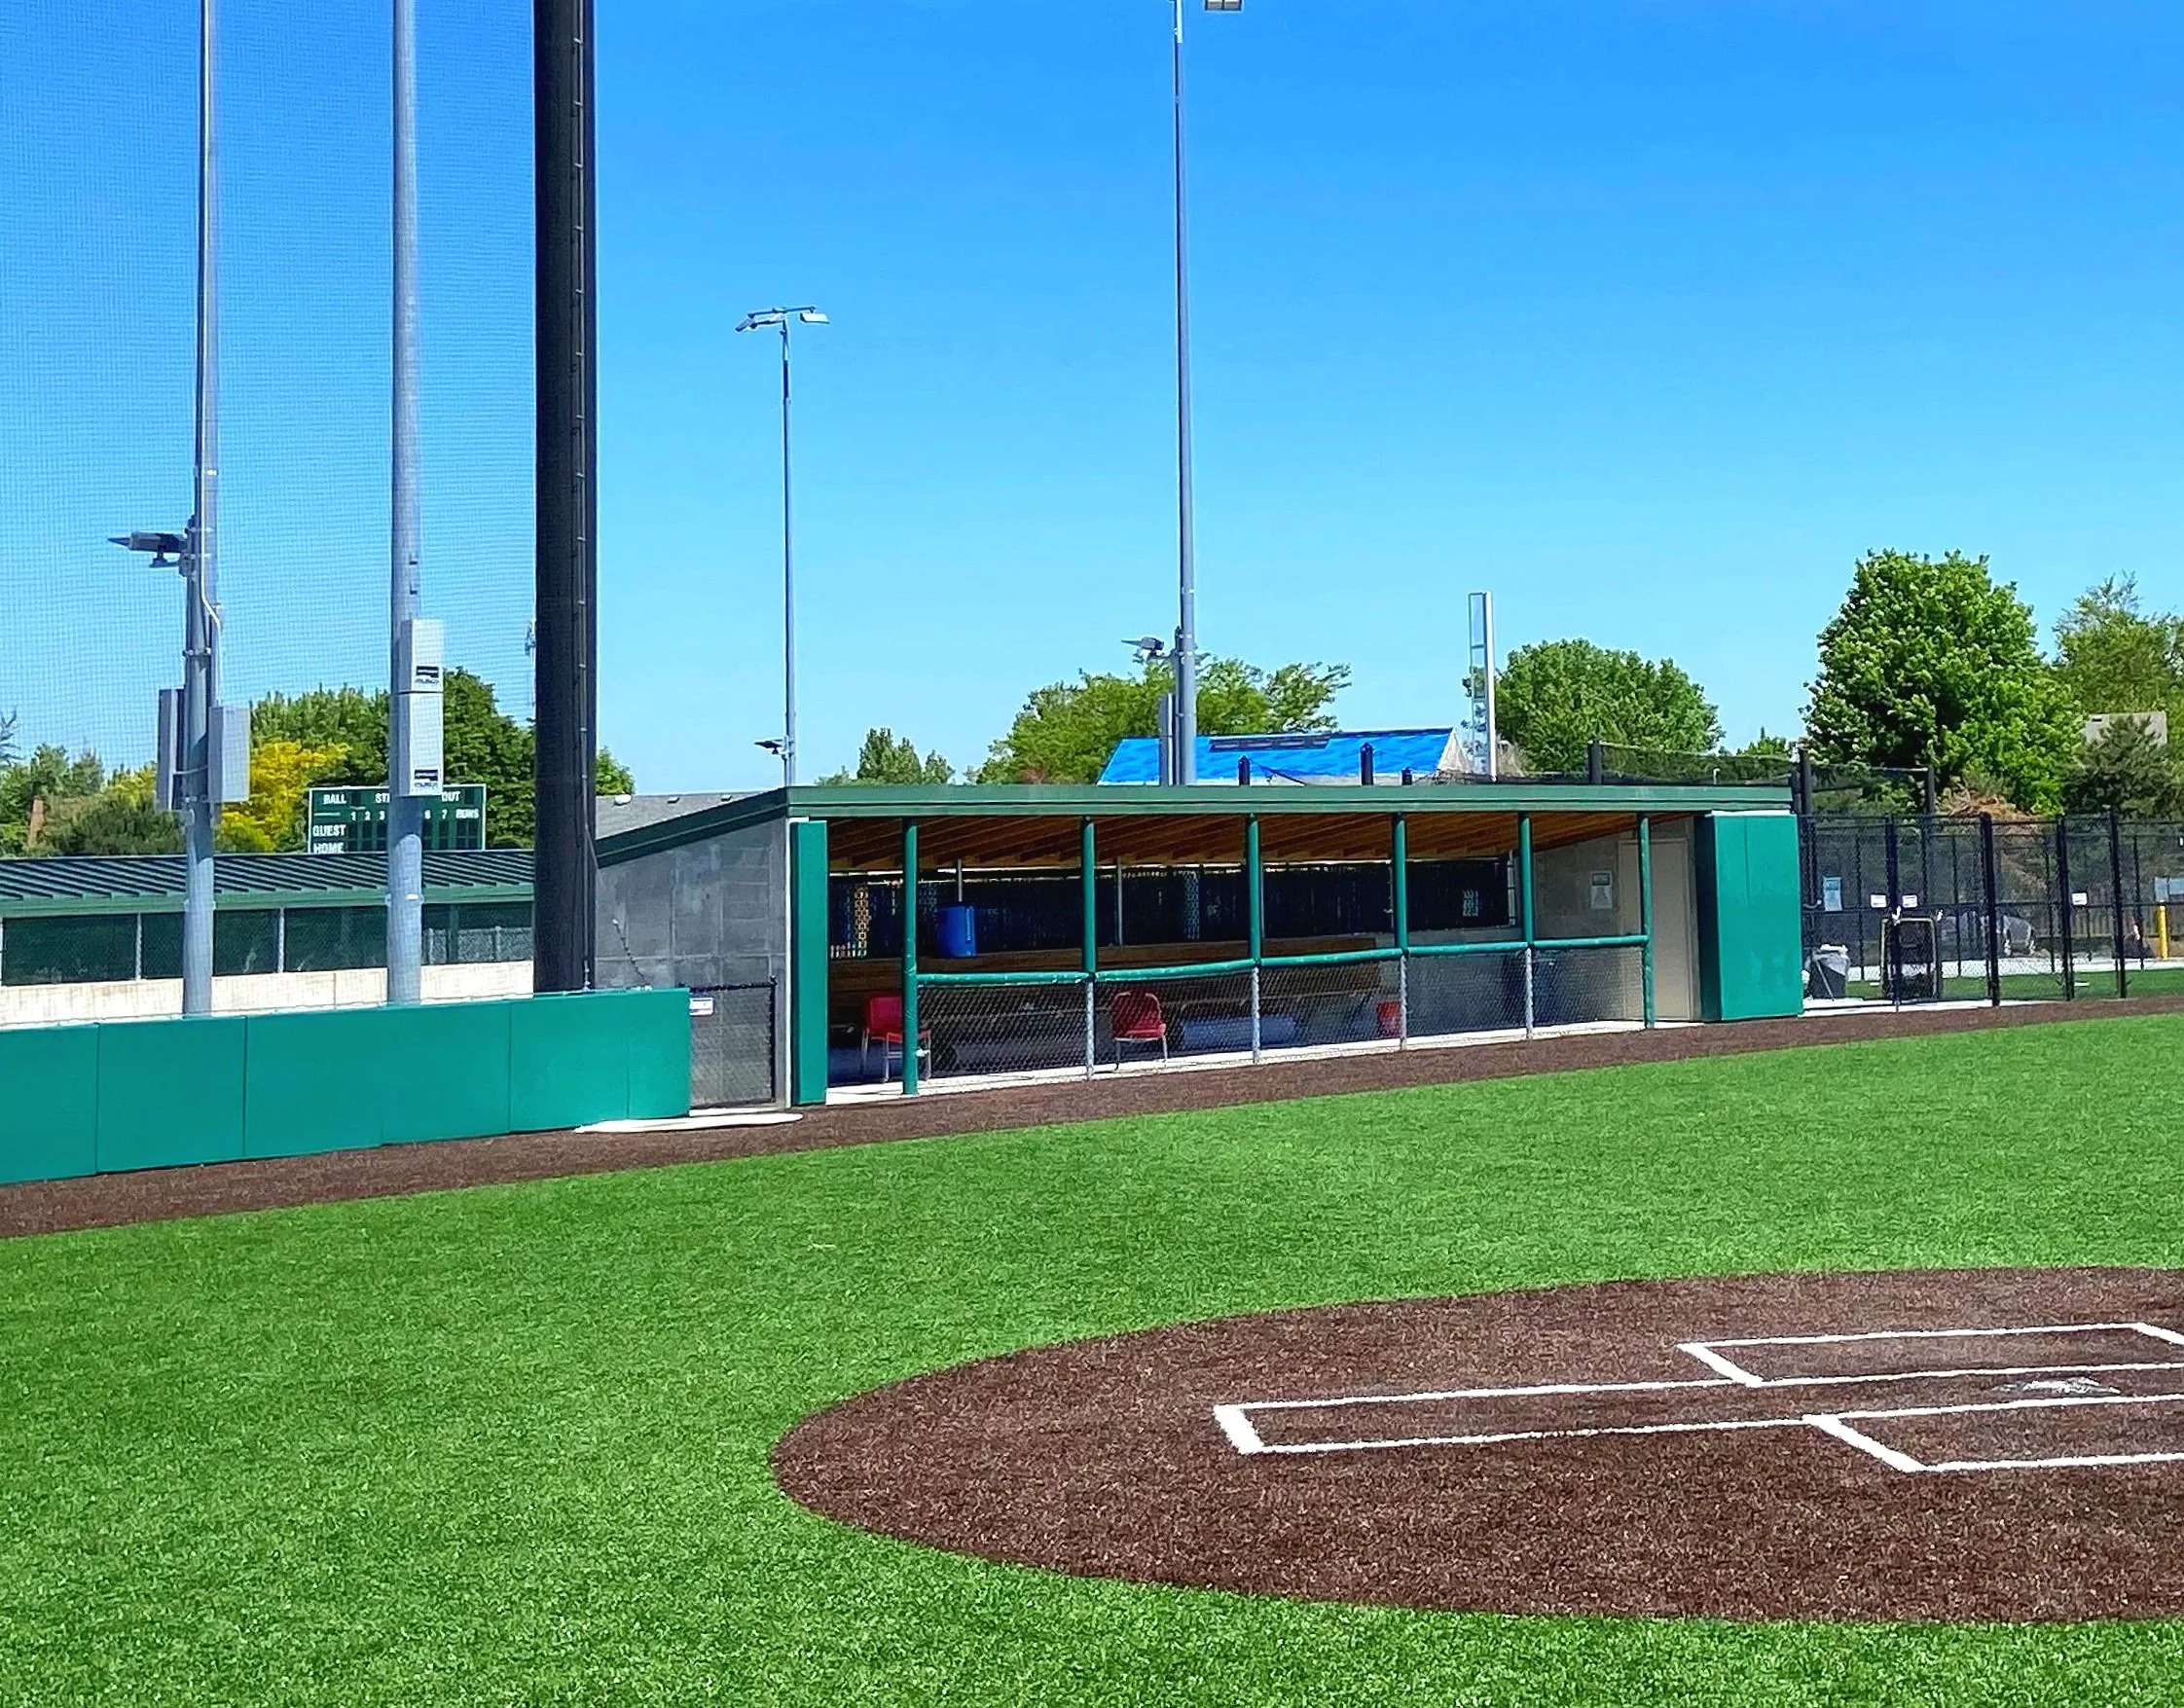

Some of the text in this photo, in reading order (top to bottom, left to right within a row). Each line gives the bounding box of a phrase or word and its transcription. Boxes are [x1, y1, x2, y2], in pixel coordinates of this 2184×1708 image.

[323, 793, 346, 804] BALL
[441, 791, 460, 802] OUT
[350, 811, 356, 820] 1
[365, 811, 371, 820] 2
[379, 810, 385, 820] 3
[442, 809, 448, 819] 7
[312, 824, 346, 837] GUEST
[313, 843, 345, 854] HOME
